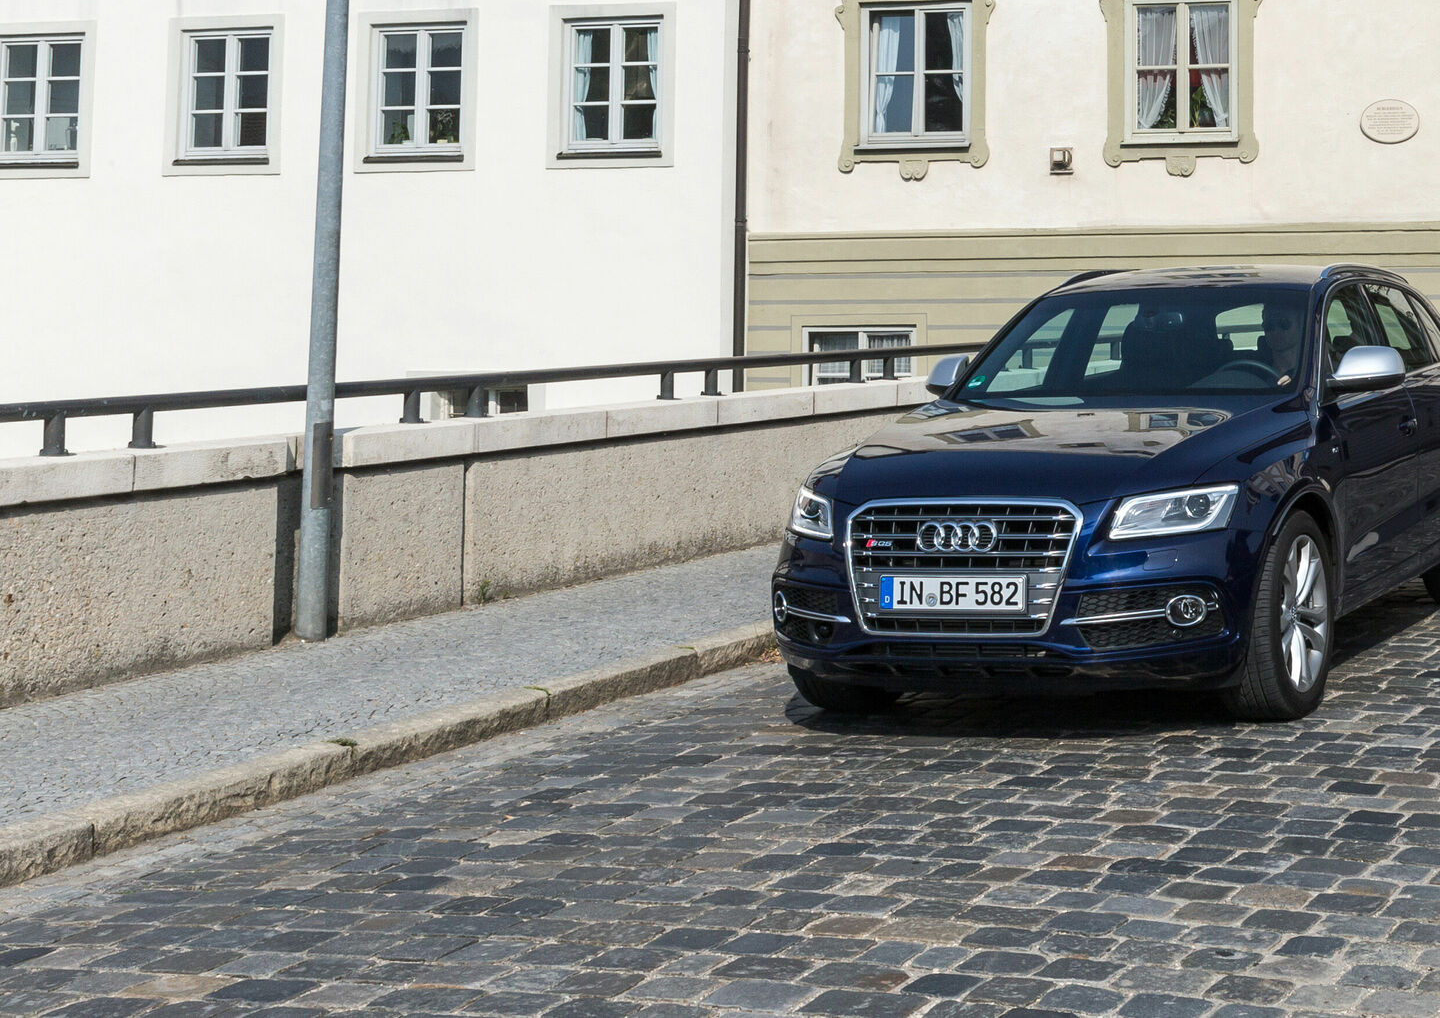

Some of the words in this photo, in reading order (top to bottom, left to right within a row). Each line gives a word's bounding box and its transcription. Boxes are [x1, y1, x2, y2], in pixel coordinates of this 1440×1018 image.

[884, 595, 890, 604] D
[896, 581, 924, 605] IN
[939, 581, 970, 606] BF
[975, 581, 1019, 606] 582
